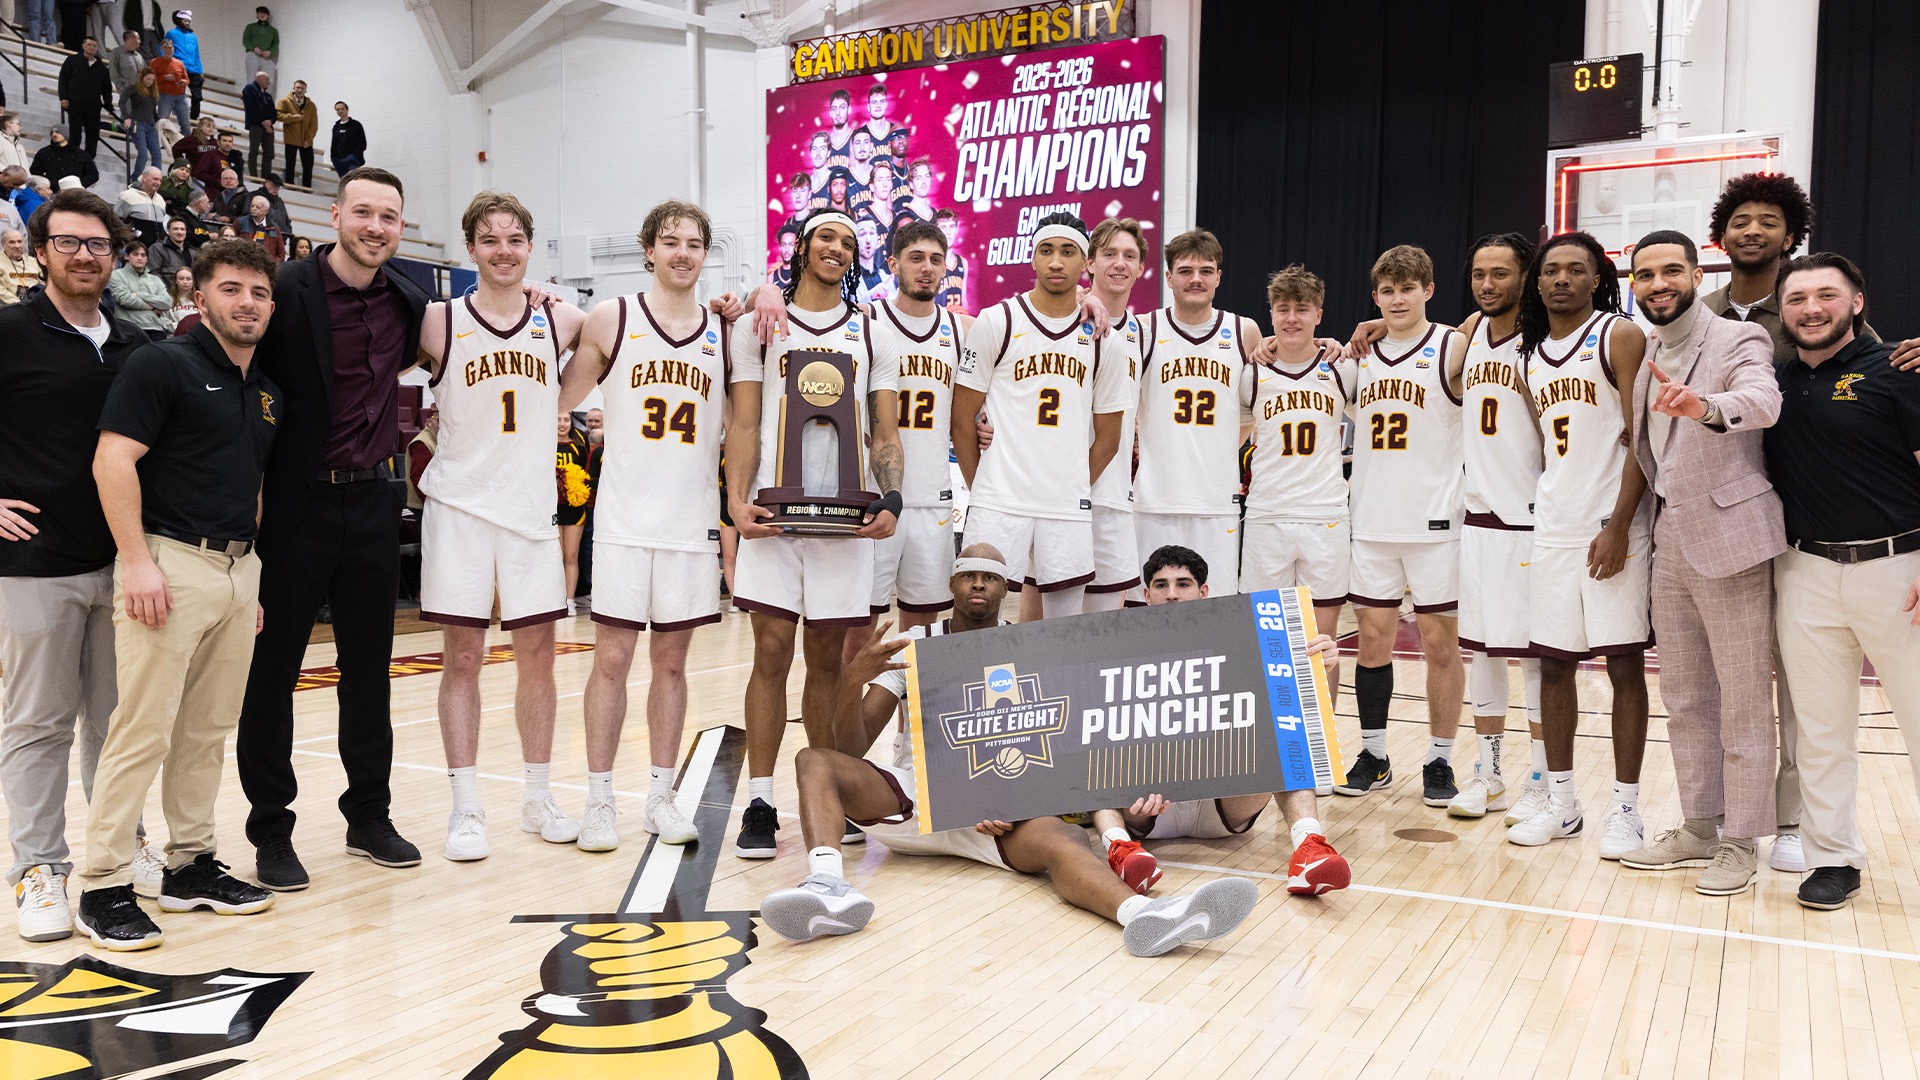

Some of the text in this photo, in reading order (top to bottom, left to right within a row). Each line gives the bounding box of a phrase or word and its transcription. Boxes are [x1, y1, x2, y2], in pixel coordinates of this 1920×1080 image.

[794, 0, 1126, 78] GANNON UNIVERSITY
[1013, 56, 1094, 94] 2025-2026
[1573, 56, 1618, 65] DAKTRONICS
[1575, 64, 1616, 92] 0.0
[959, 81, 1151, 140] ATLANTIC REGIONAL
[954, 124, 1150, 202] CHAMPIONS
[987, 236, 1033, 266] GOLDE
[465, 350, 547, 388] GANNON
[631, 360, 712, 402] GANNON
[1013, 352, 1087, 388] GANNON
[1161, 357, 1231, 388] GANNON
[802, 380, 843, 397] NCAA
[1037, 387, 1061, 427] 2
[1174, 388, 1216, 426] 32
[1263, 390, 1335, 421] GANNON
[1360, 378, 1426, 410] GANNON
[501, 389, 516, 433] 1
[640, 395, 697, 445] 34
[897, 389, 936, 430] 12
[1480, 396, 1498, 437] 0
[1280, 420, 1317, 456] 10
[1370, 412, 1409, 450] 22
[1552, 414, 1570, 457] 5
[786, 505, 861, 517] REGIONAL CHAMPION
[991, 678, 1014, 688] NCAA
[1100, 655, 1226, 703] TICKET
[1256, 602, 1307, 782] SECTION 4 ROW 5 SEAT 26
[957, 707, 1058, 738] ELITE EIGHT
[976, 709, 995, 718] 2026
[1011, 704, 1033, 712] MEN'S
[1082, 691, 1256, 745] PUNCHED
[985, 736, 1031, 748] PITTSBURGH
